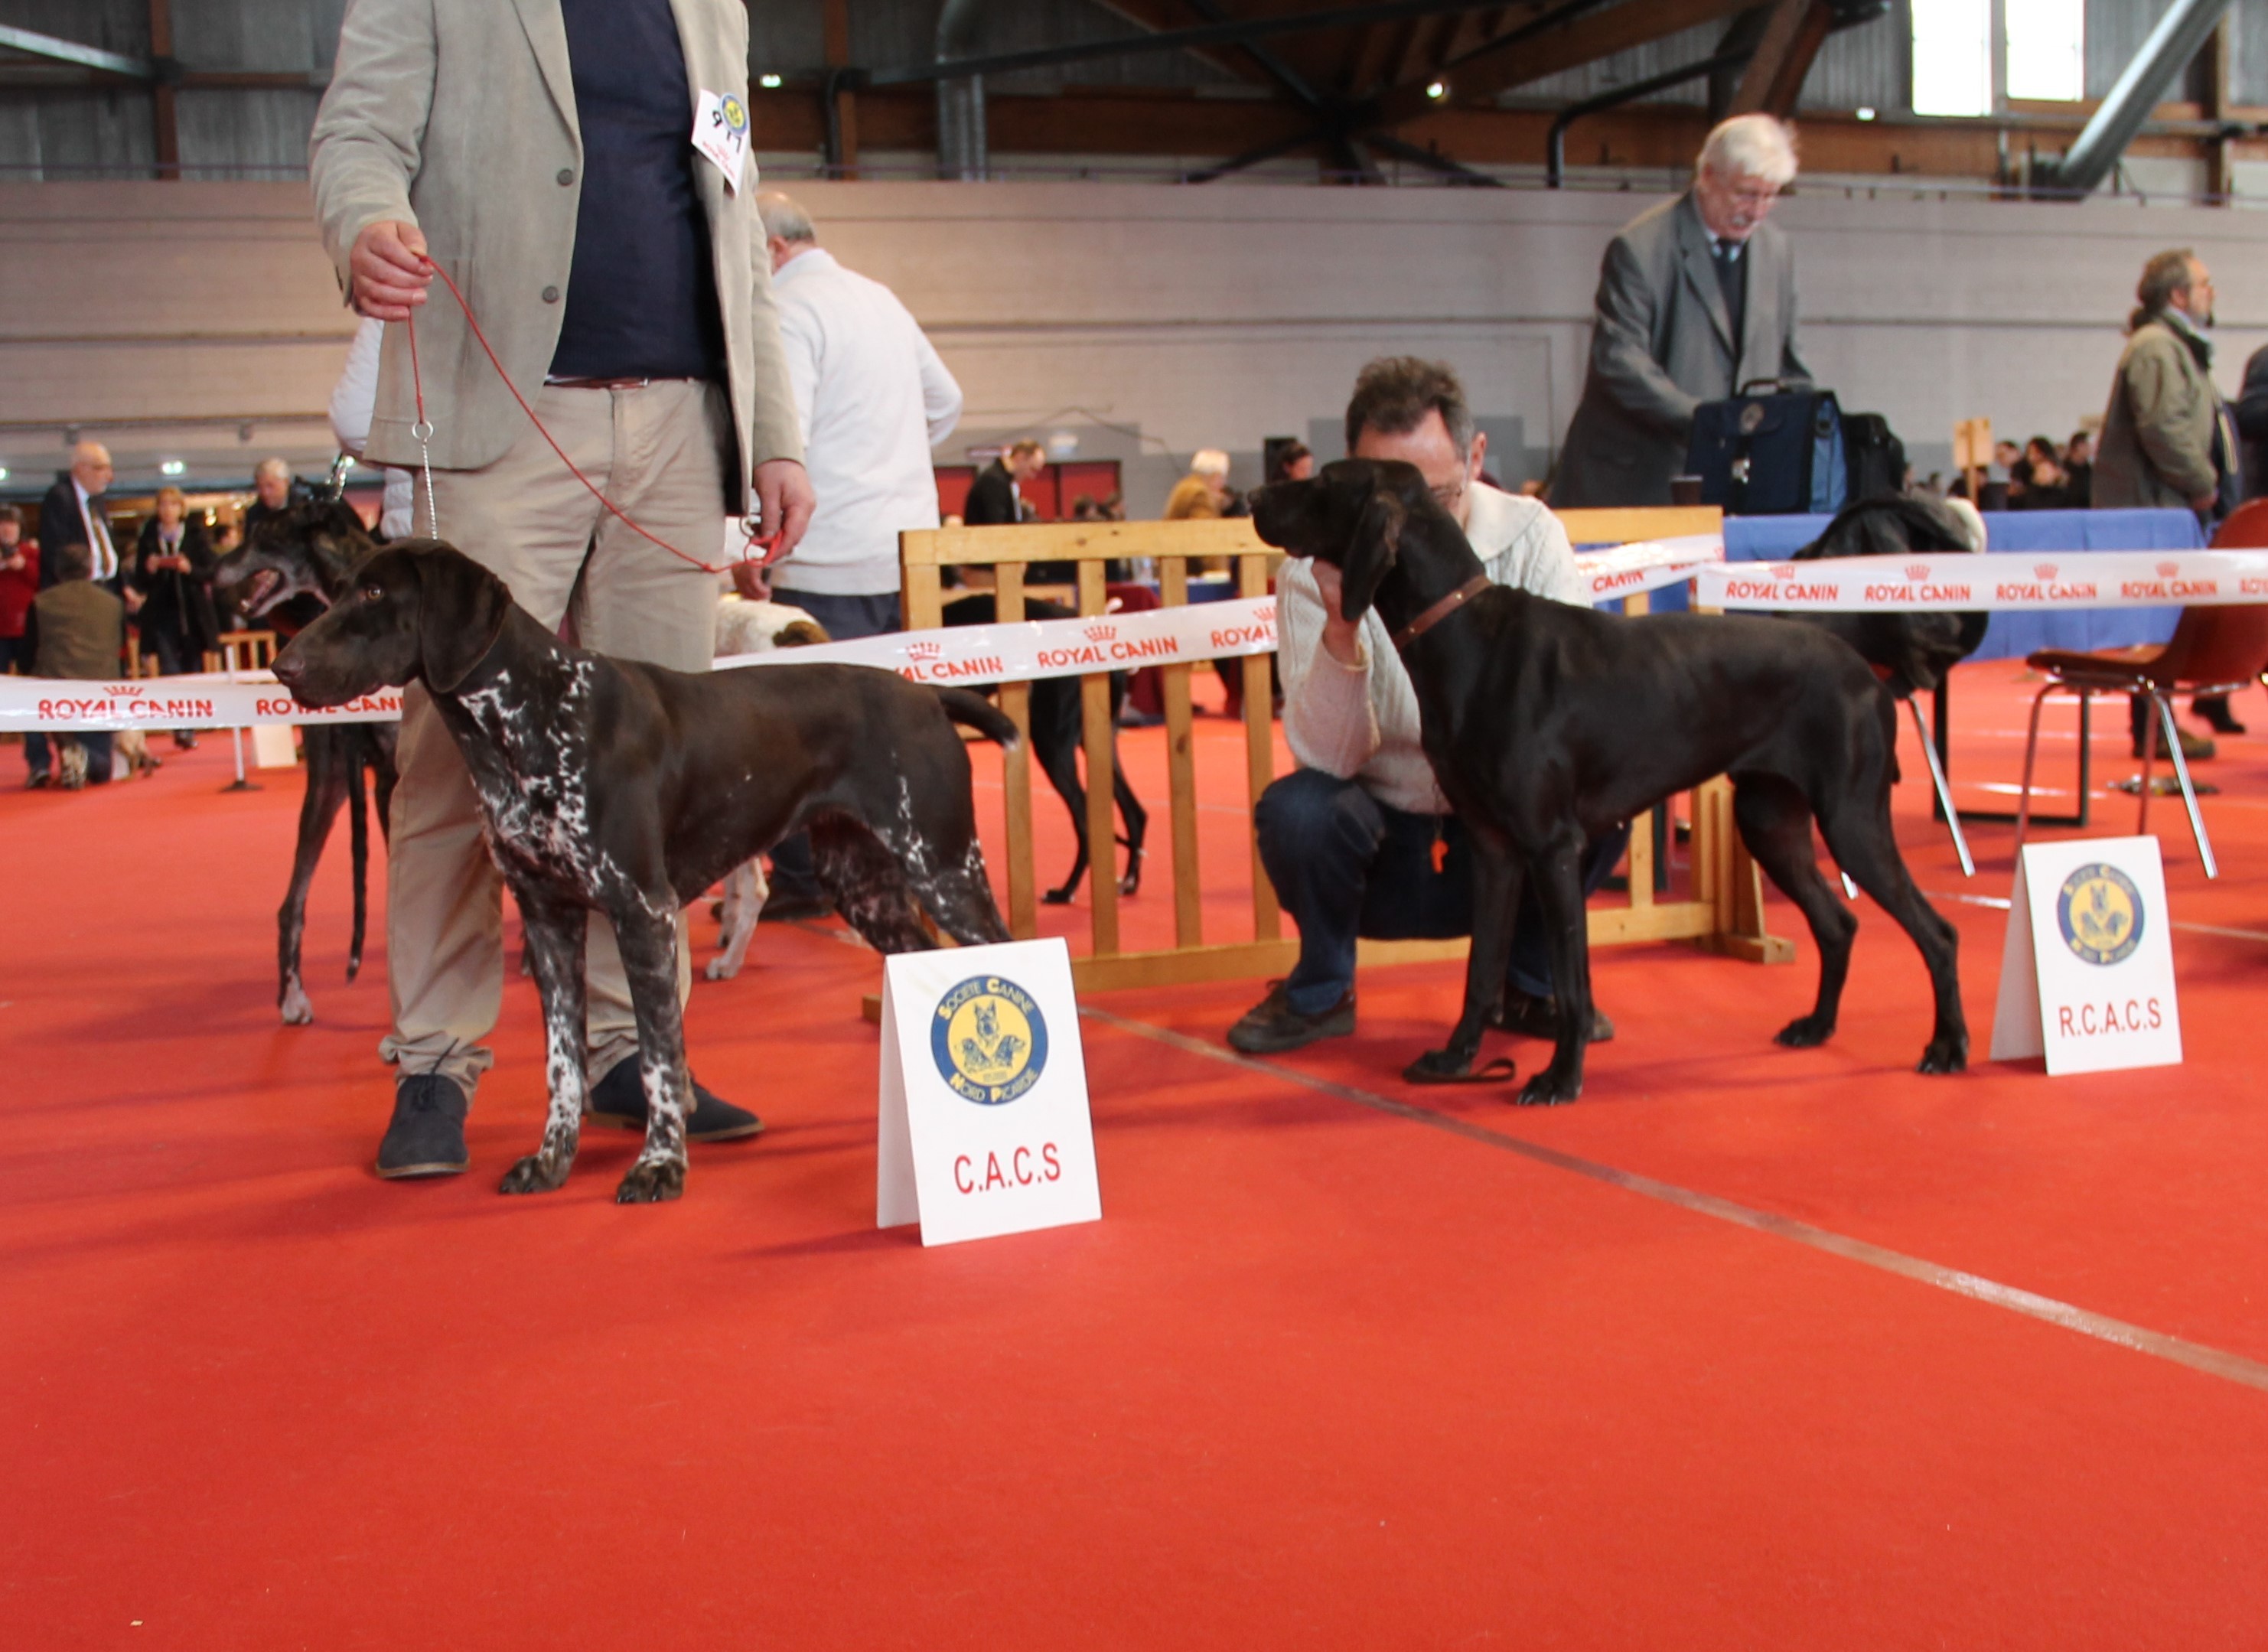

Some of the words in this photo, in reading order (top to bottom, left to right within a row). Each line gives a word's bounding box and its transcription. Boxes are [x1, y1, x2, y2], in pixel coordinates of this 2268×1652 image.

[1726, 580, 1779, 600] ROYAL
[1785, 583, 1839, 601] CANIN
[1865, 584, 1916, 601] ROYAL
[1920, 584, 1971, 601] CANIN
[1996, 582, 2044, 600] ROYAL
[2121, 580, 2168, 598] ROYAL
[1211, 624, 1278, 647] ROYAL
[1037, 646, 1106, 668] ROYAL
[1110, 636, 1178, 660] CANIN
[932, 656, 1004, 678] CANIN
[38, 699, 122, 720] ROYAL
[129, 699, 214, 718] CANIN
[2058, 997, 2162, 1038] R.C.A.C.S
[953, 1142, 1061, 1194] C.A.C.S
